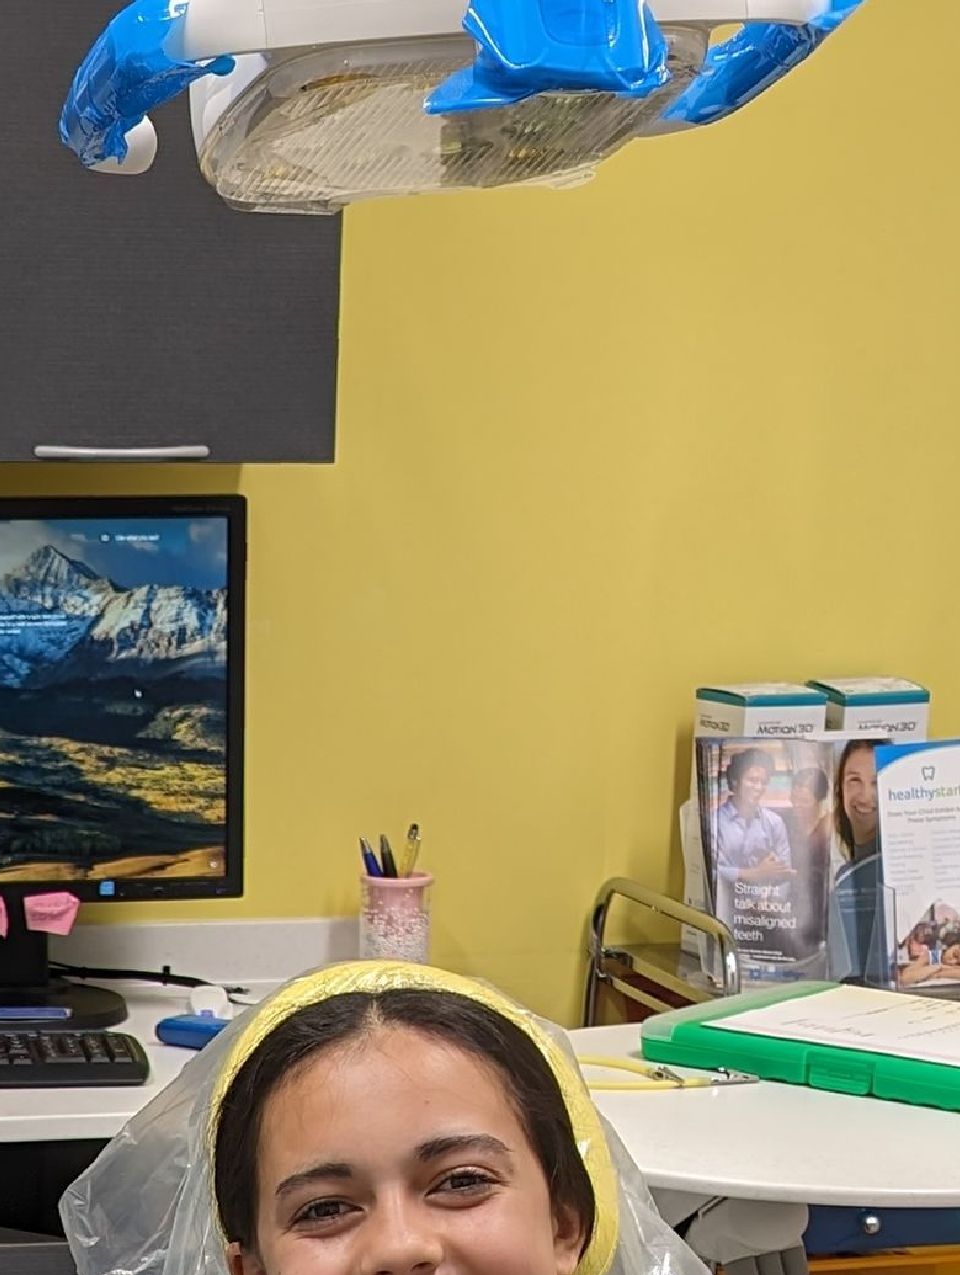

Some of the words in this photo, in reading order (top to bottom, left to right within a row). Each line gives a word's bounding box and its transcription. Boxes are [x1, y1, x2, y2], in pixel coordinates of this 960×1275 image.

[734, 882, 780, 898] Straight
[734, 898, 756, 911] talk
[757, 900, 792, 914] about
[733, 914, 797, 930] misaligned
[733, 929, 765, 941] teeth
